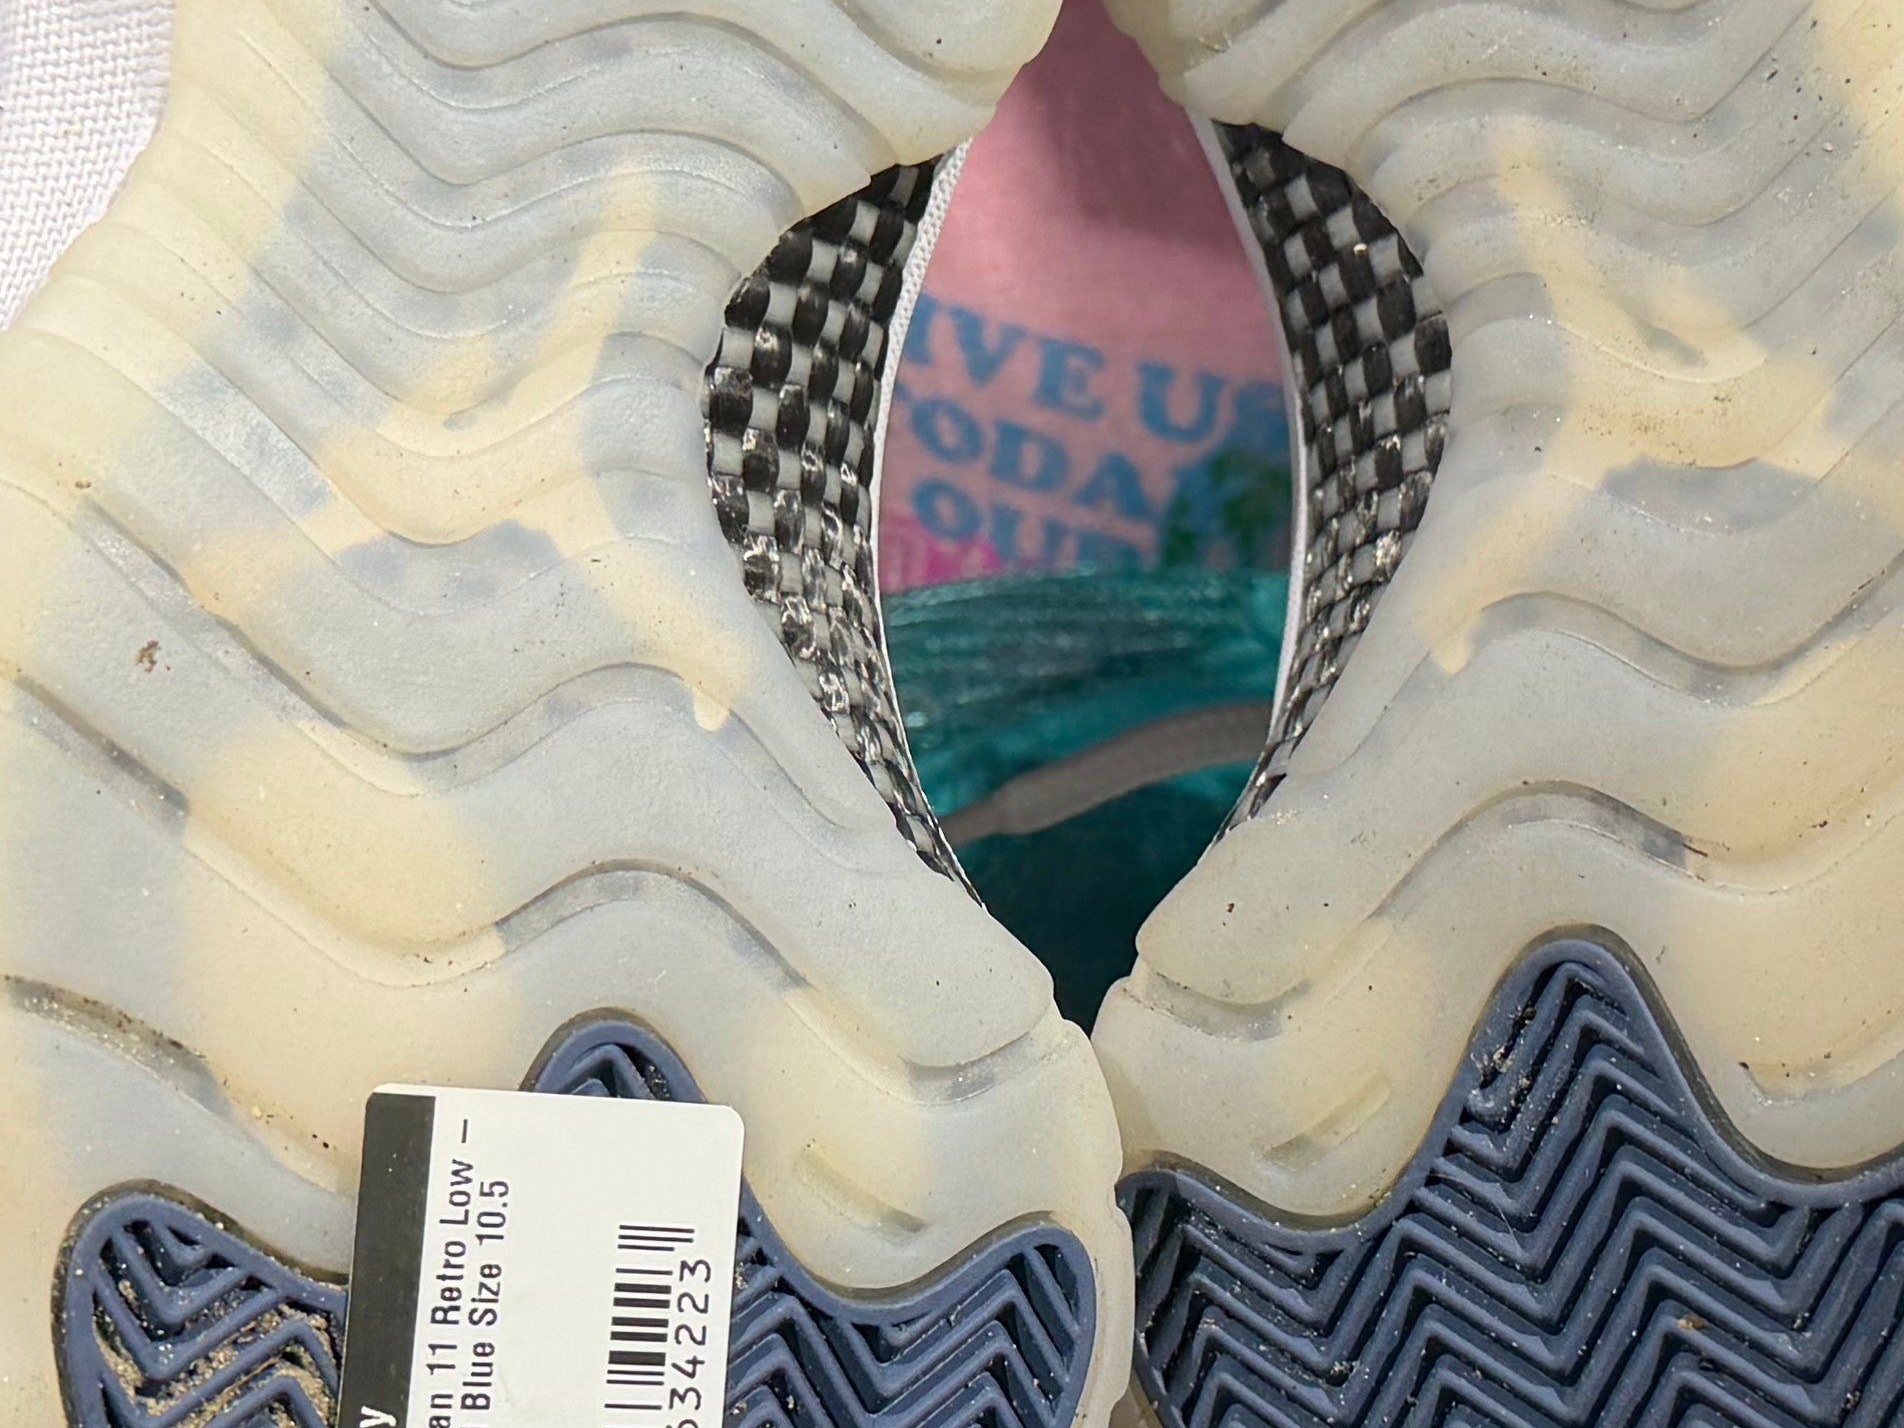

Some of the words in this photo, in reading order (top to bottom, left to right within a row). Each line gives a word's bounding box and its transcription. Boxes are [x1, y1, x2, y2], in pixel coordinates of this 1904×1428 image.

[439, 1158, 474, 1225] Low
[474, 1180, 510, 1246] 10.5
[430, 1240, 467, 1325] Retro
[467, 1263, 503, 1327] Size
[425, 1342, 458, 1375] 11
[460, 1341, 495, 1411] Blue
